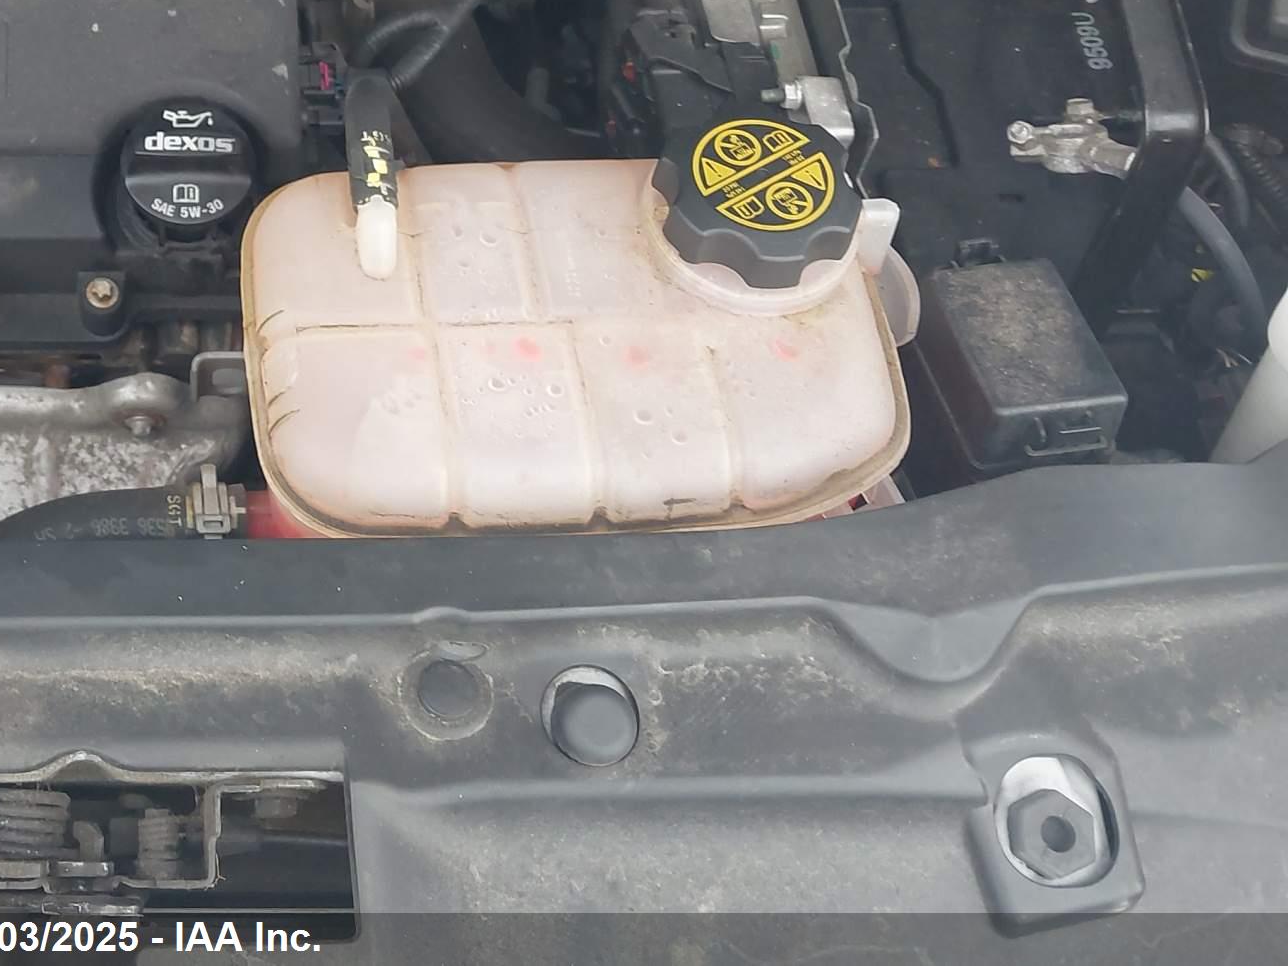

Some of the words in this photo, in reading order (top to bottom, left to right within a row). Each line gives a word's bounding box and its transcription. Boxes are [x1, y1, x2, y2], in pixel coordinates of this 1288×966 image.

[1070, 11, 1114, 70] 9509U
[144, 131, 235, 152] dexos
[151, 198, 176, 217] SAE
[180, 198, 224, 219] 5W-30
